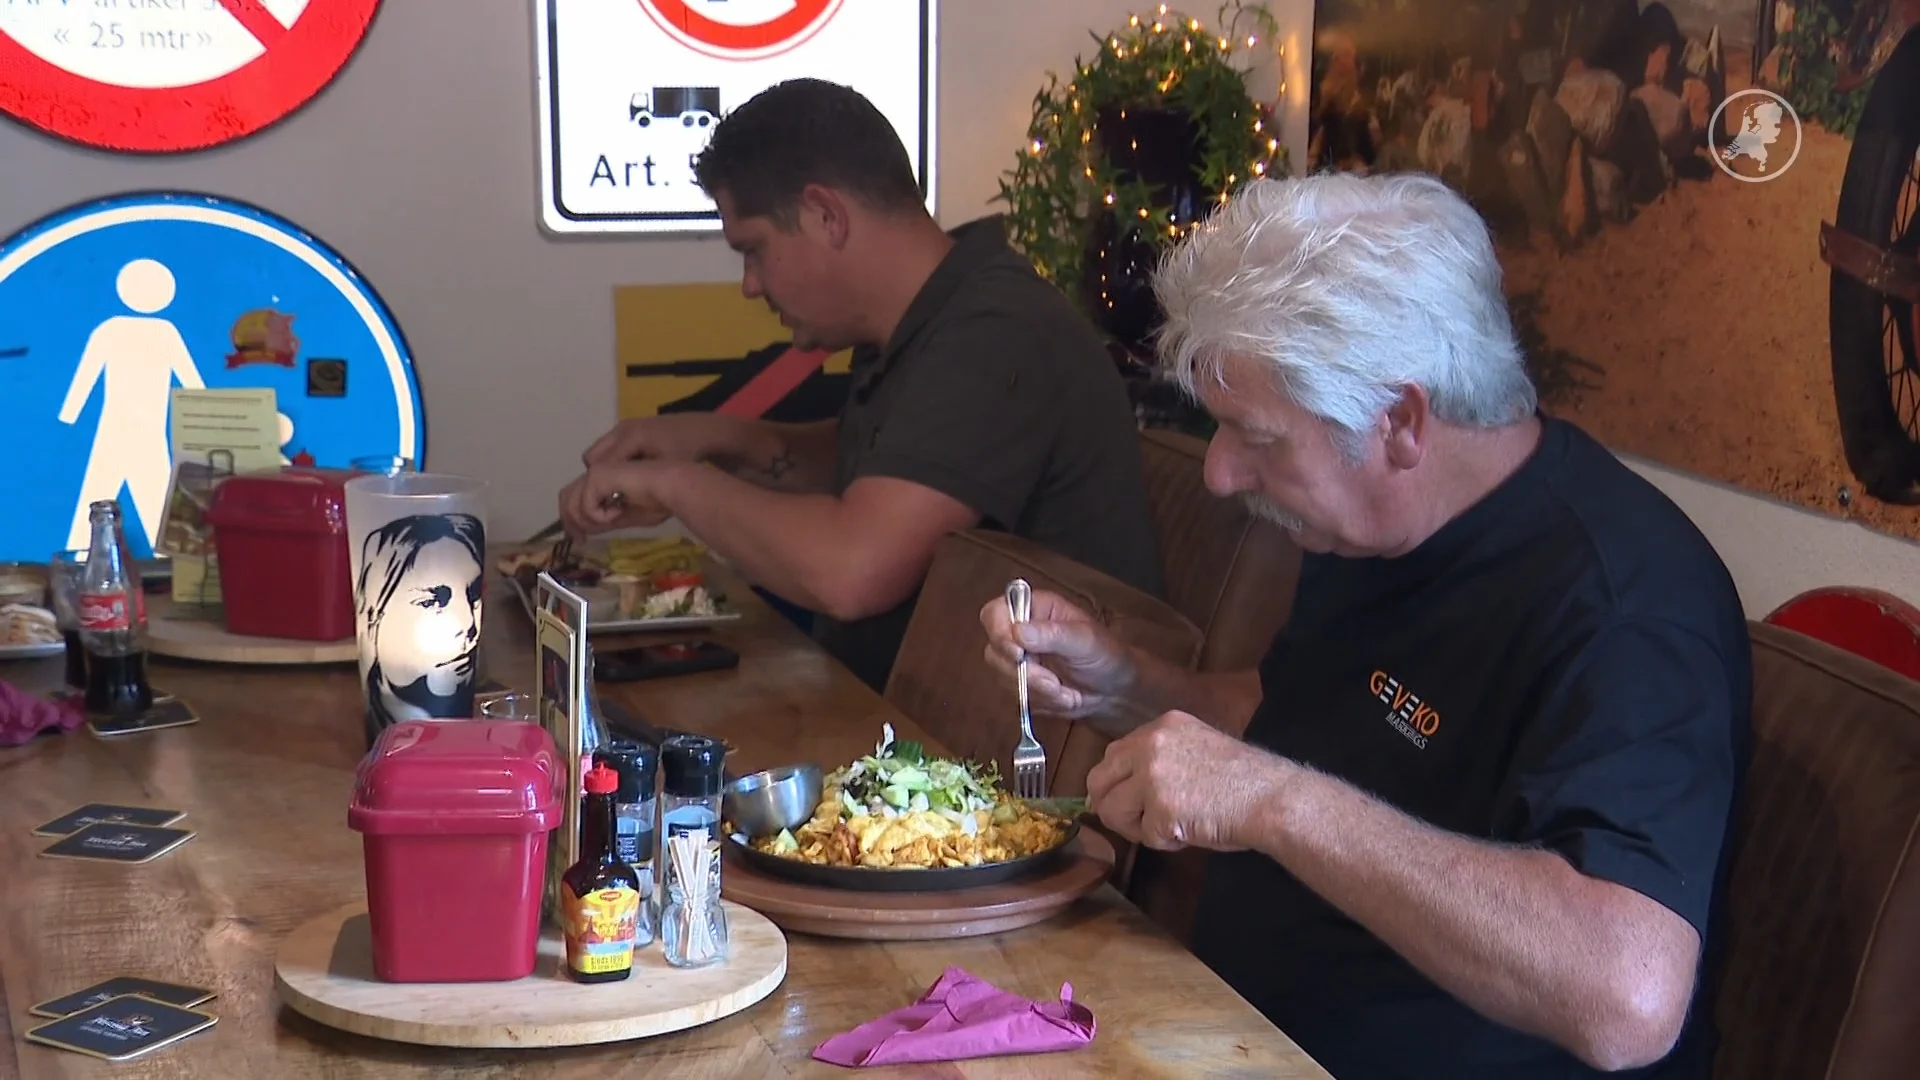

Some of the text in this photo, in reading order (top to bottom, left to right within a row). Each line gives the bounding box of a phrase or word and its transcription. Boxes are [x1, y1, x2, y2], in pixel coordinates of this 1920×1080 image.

[90, 21, 124, 48] 25
[589, 153, 670, 187] Art.
[1370, 670, 1440, 736] GEVEKO
